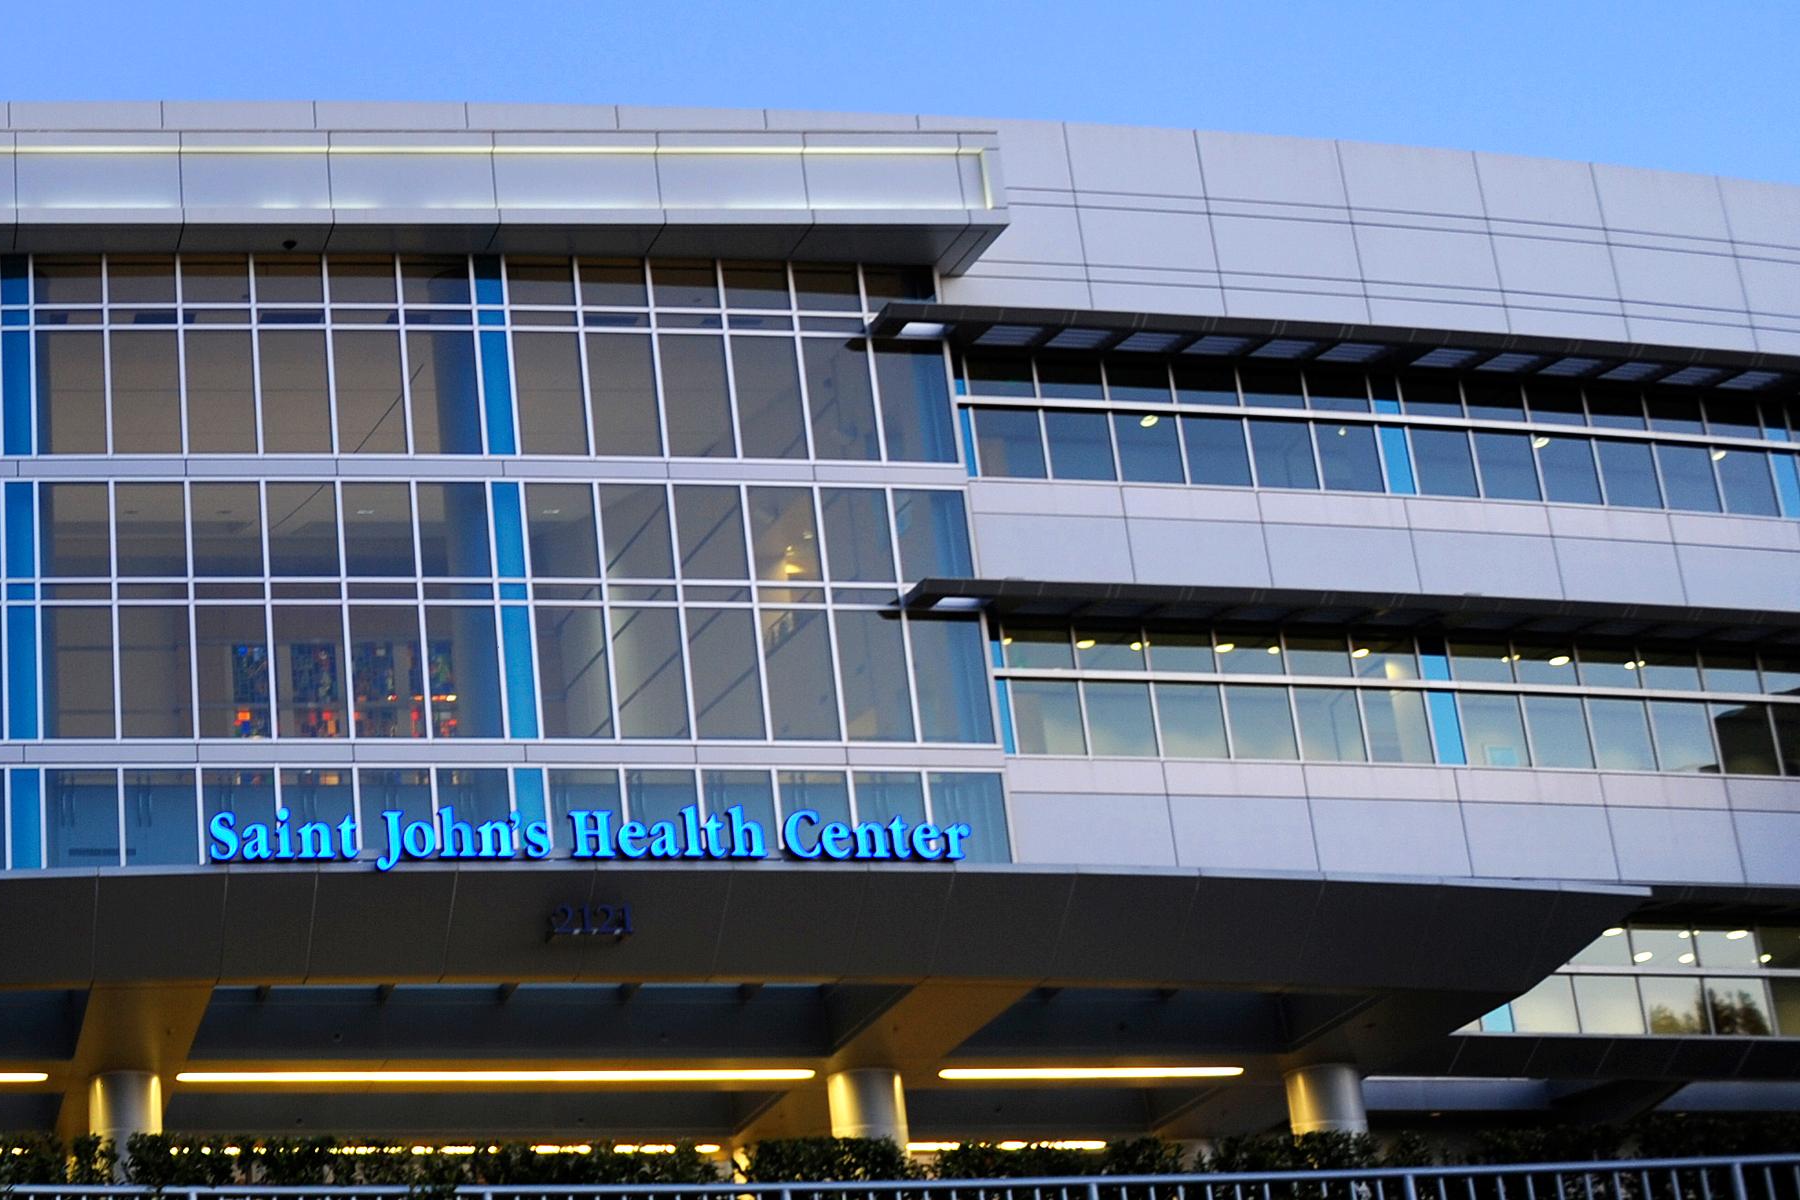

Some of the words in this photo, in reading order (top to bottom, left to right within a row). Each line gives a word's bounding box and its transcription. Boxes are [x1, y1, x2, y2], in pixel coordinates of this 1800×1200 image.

[209, 807, 360, 861] Saint
[375, 805, 552, 872] John's
[568, 803, 769, 860] Health
[782, 808, 971, 861] Center
[552, 902, 633, 934] 2121
